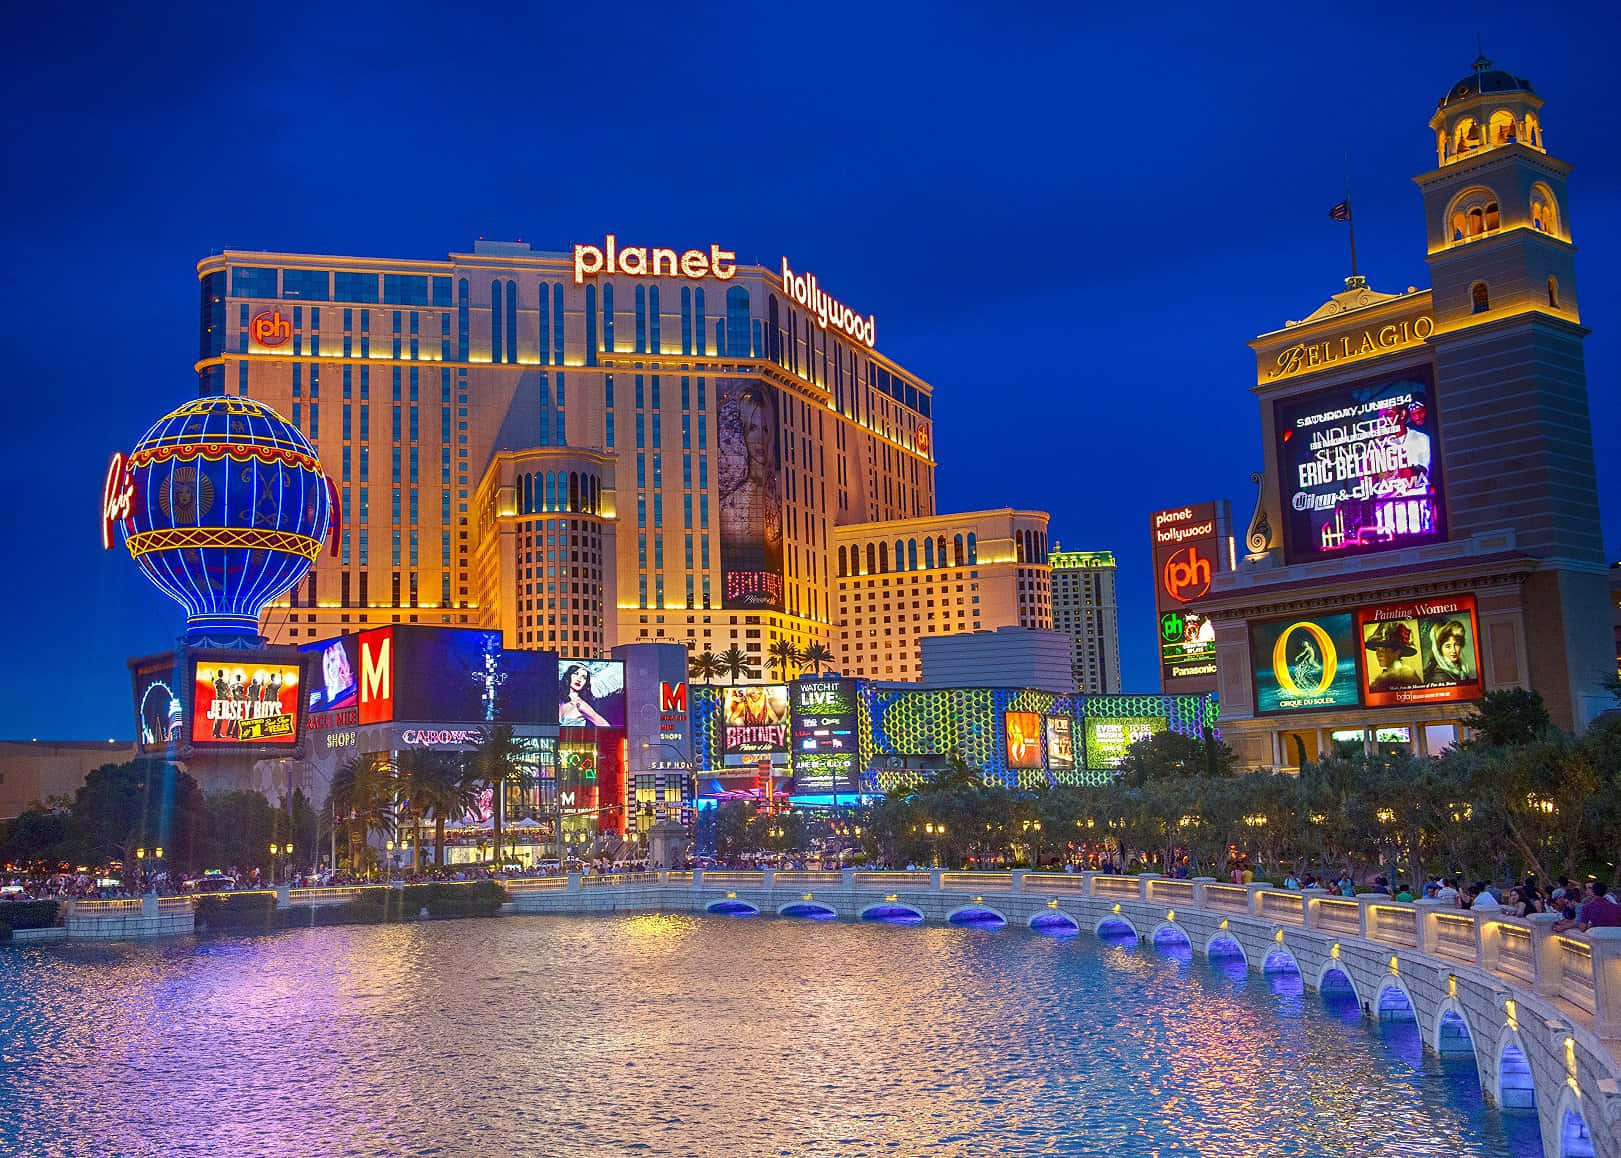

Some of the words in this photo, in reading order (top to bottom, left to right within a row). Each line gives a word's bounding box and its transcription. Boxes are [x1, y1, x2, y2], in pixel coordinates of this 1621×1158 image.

[574, 234, 737, 284] planet
[782, 255, 876, 348] hollywood
[256, 311, 291, 342] ph
[1268, 316, 1434, 378] BELLAGIO
[1299, 459, 1333, 488] ERIC
[103, 452, 134, 550] Paris
[1156, 507, 1192, 528] planet
[1157, 522, 1212, 543] hollywood
[1169, 547, 1211, 597] ph
[1374, 608, 1413, 622] Painting
[1415, 603, 1458, 616] Women
[1164, 613, 1183, 637] ph
[361, 638, 390, 703] M
[1172, 663, 1217, 677] Panasonic
[1272, 621, 1338, 697] O
[659, 681, 687, 713] M
[800, 683, 831, 692] WATCH
[832, 682, 839, 691] IT
[801, 692, 839, 705] LIVE:
[206, 700, 251, 720] JERSEY
[253, 700, 283, 718] BOYS
[1280, 700, 1304, 708] CIRQUE
[327, 731, 356, 748] SHOPS
[402, 729, 452, 746] CABO
[726, 725, 787, 750] BRITNEY
[561, 792, 575, 806] M
